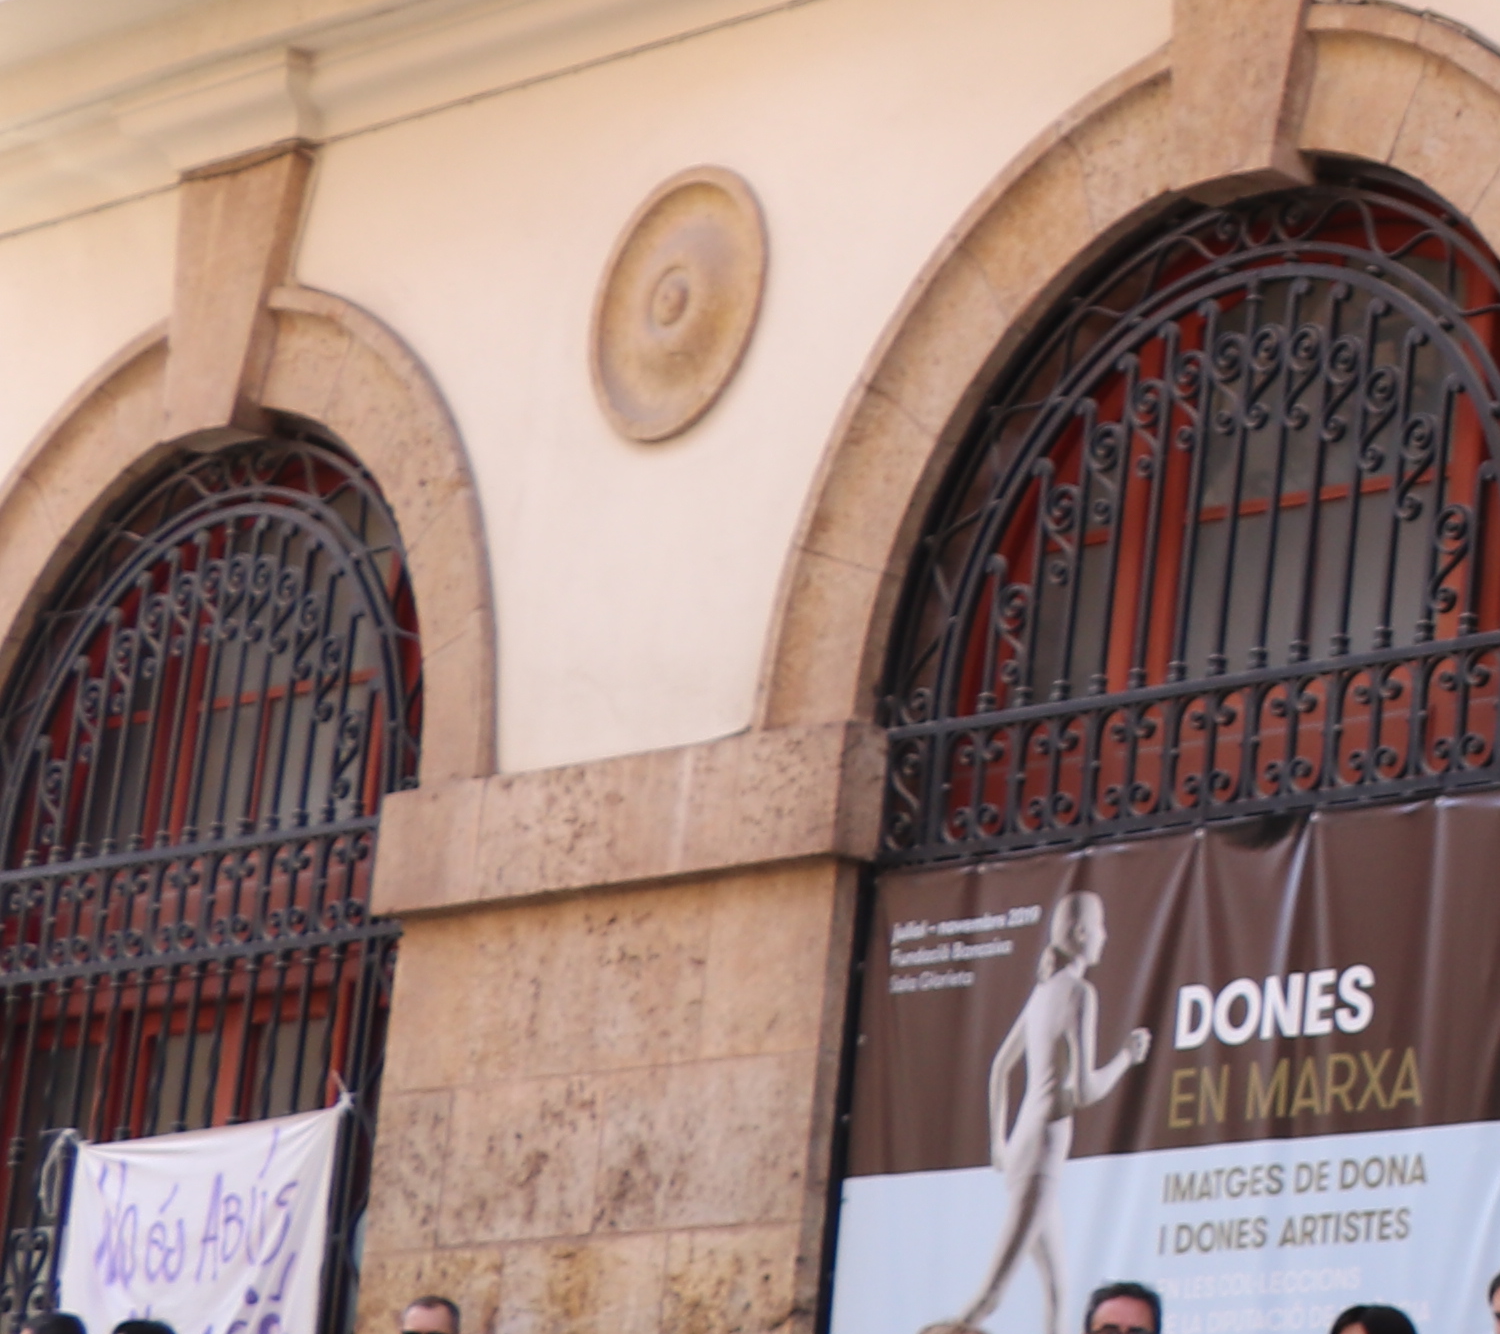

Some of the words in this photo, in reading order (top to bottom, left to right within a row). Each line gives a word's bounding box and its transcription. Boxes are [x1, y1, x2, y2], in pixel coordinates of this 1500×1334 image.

[1174, 964, 1376, 1050] DONES
[1168, 1064, 1230, 1129] EN
[1245, 1046, 1423, 1121] MARXA
[1162, 1164, 1285, 1204] IMATGES
[1294, 1160, 1329, 1194] DE
[1339, 1152, 1427, 1191] DONA
[1158, 1225, 1167, 1255] I
[1174, 1217, 1268, 1255] DONES
[1278, 1207, 1411, 1248] ARTISTES
